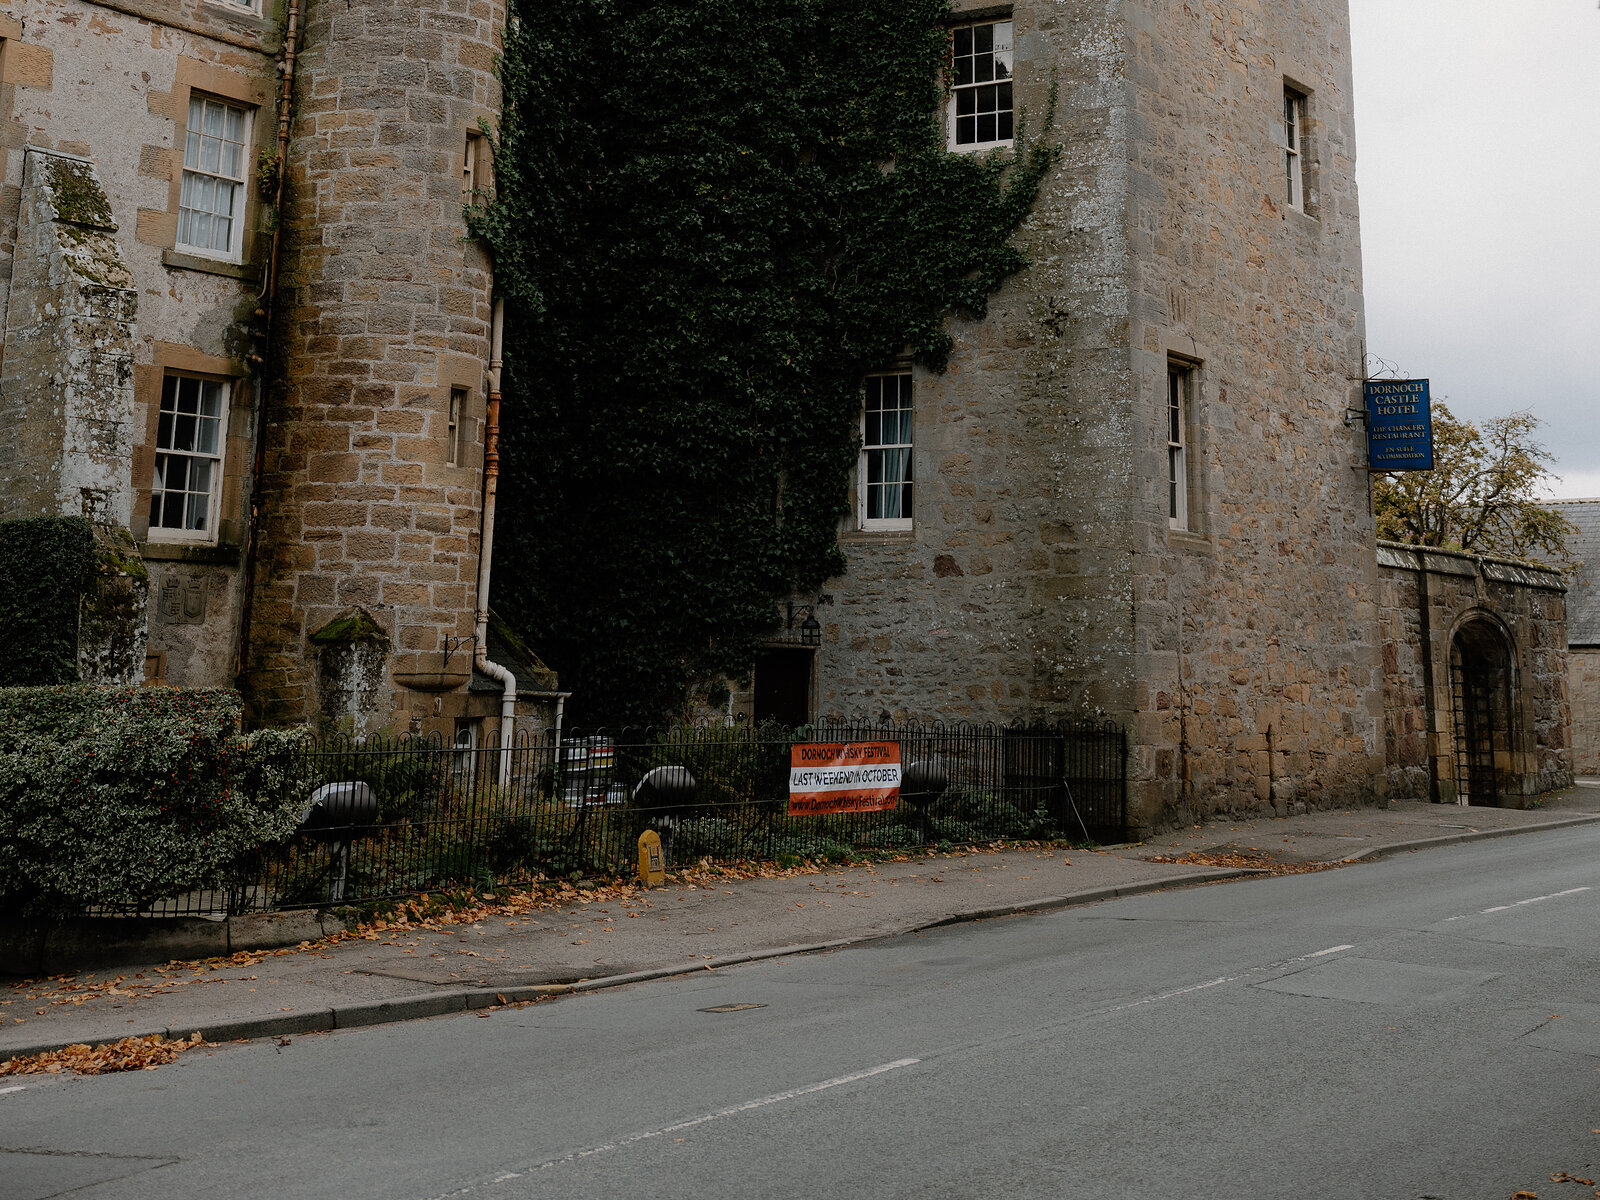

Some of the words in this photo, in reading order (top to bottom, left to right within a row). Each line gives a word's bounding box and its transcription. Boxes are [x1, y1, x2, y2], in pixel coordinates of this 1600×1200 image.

[1370, 384, 1423, 394] DORNOCH
[1375, 395, 1419, 404] CASTLE
[1378, 405, 1418, 414] HOTEL
[801, 748, 835, 760] DORNOCH
[835, 747, 863, 760] WHISKY
[864, 746, 890, 758] FESTIVAL
[793, 772, 813, 786] LAST
[814, 770, 854, 785] WEEKEND
[854, 770, 861, 783] IN
[862, 768, 899, 783] OCTOBER
